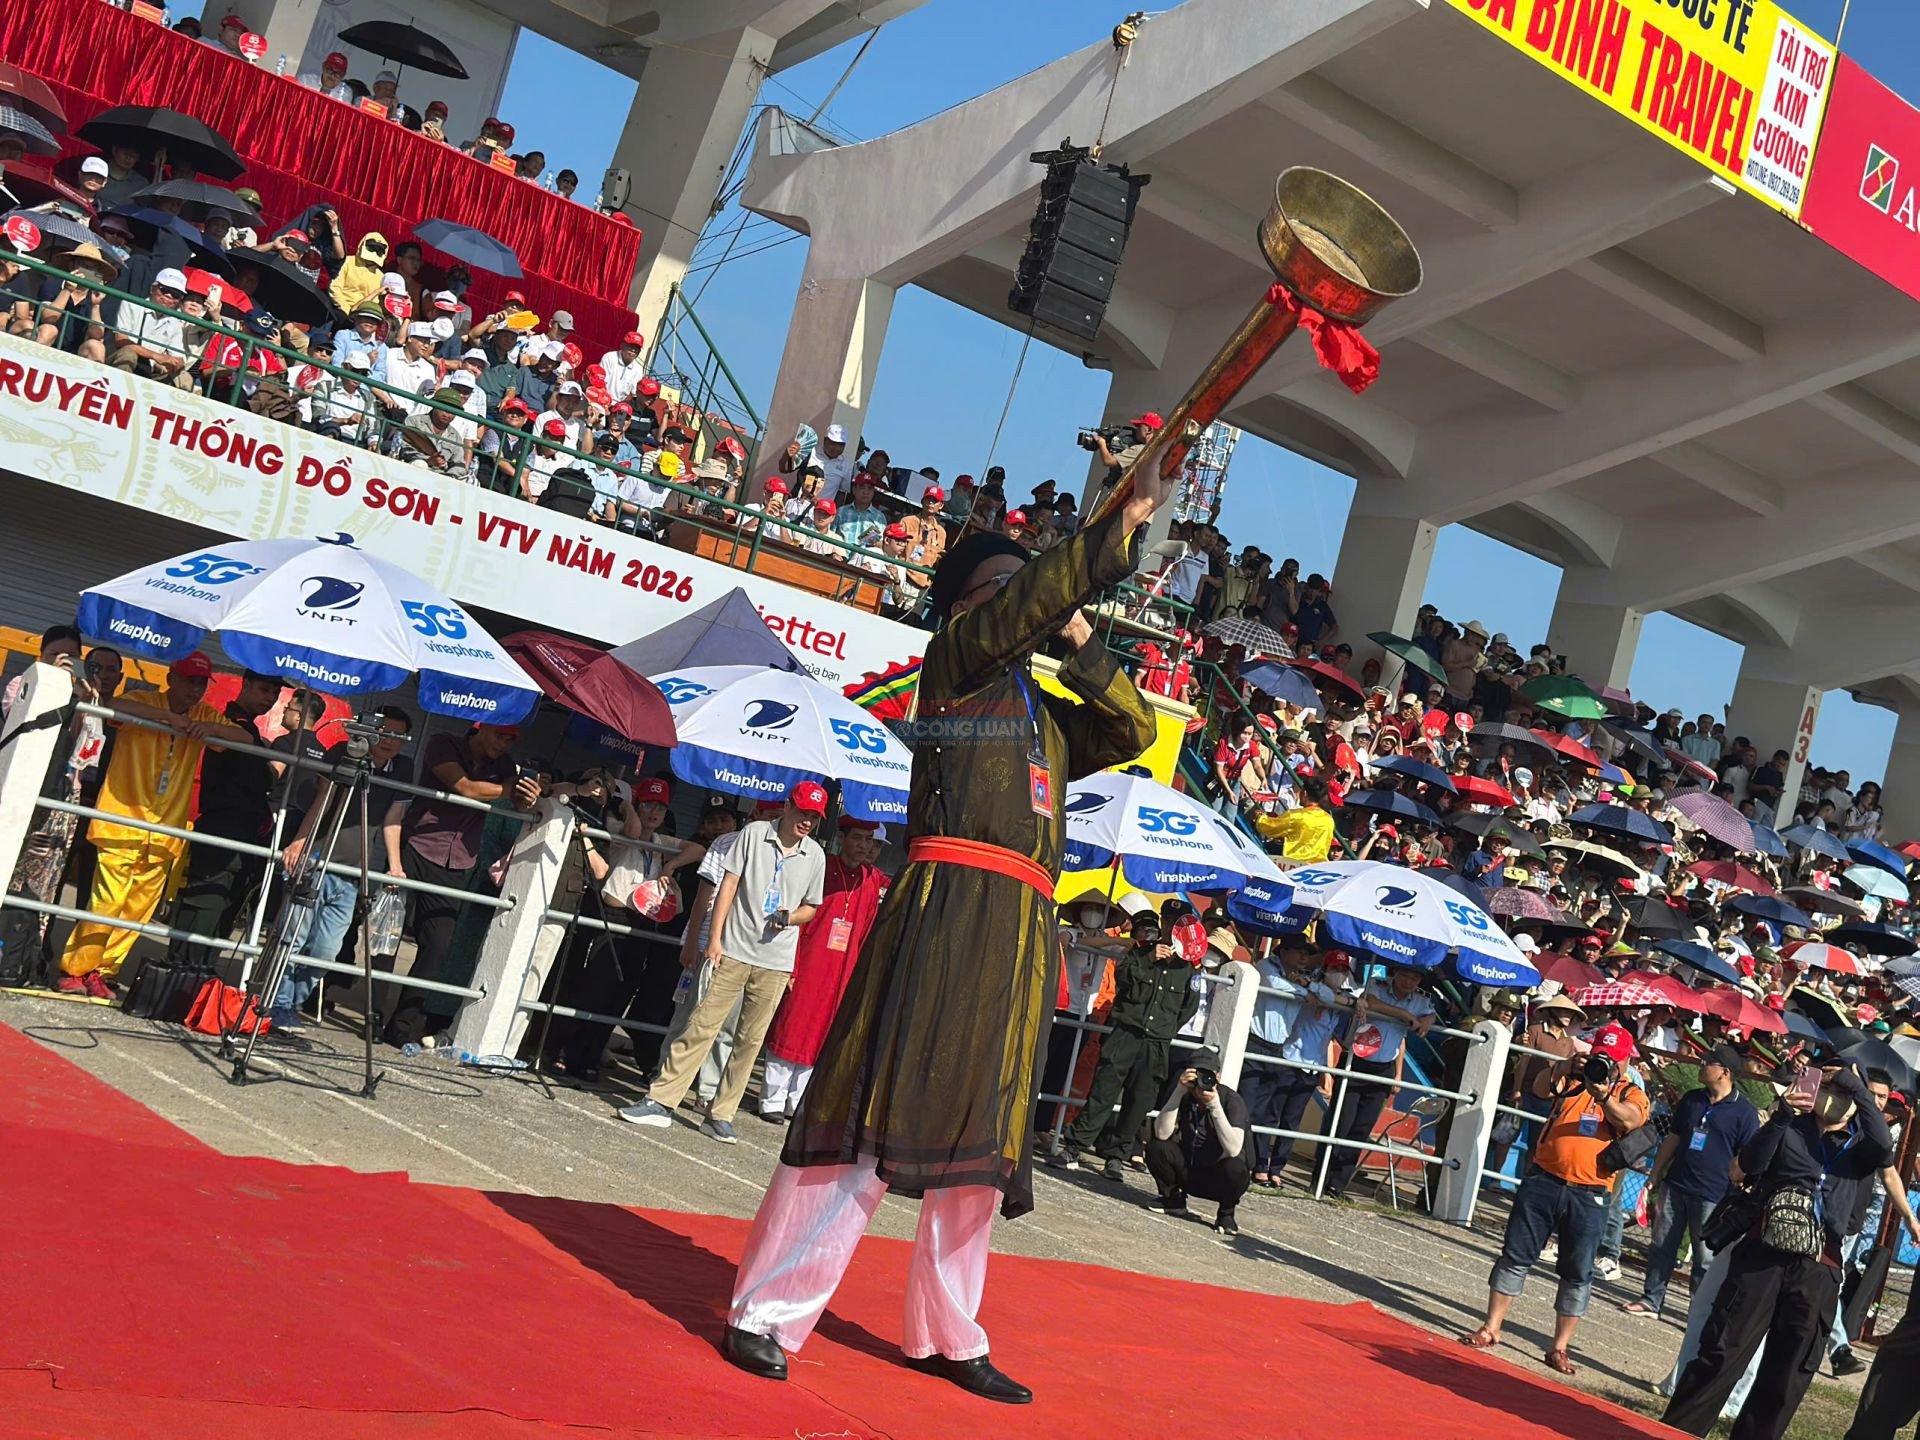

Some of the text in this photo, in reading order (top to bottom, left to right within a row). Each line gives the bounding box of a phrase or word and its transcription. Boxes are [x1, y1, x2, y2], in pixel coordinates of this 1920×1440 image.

[1777, 28, 1829, 97] TÀI TRỢ
[1630, 20, 1754, 176] TRAVEL
[1773, 77, 1808, 129] KIM
[1753, 116, 1808, 180] CƯƠNG
[1893, 186, 1920, 234] A
[149, 405, 284, 475] THỐNG
[296, 456, 354, 496] ĐỒ
[362, 477, 440, 527] SƠN
[476, 511, 542, 556] VTV
[546, 534, 615, 579] NĂM
[621, 558, 694, 603] 2026
[144, 576, 221, 603] vinaphone
[296, 607, 358, 626] VNPT
[109, 617, 171, 648] vinaphone
[757, 605, 846, 661] iettel
[424, 639, 495, 660] vinaphone
[275, 654, 361, 687] vinaphone
[821, 669, 840, 682] bạn
[440, 689, 497, 711] vinaphone
[739, 728, 790, 744] VNPT
[1794, 706, 1815, 764] A3
[845, 752, 909, 772] vinaphone
[714, 767, 785, 793] vinaphone
[868, 798, 907, 815] vinaph
[1142, 834, 1213, 851] vinaphone
[1155, 871, 1218, 884] vinaphone
[1374, 904, 1416, 919] VNPT
[1361, 931, 1418, 957] vinaphone
